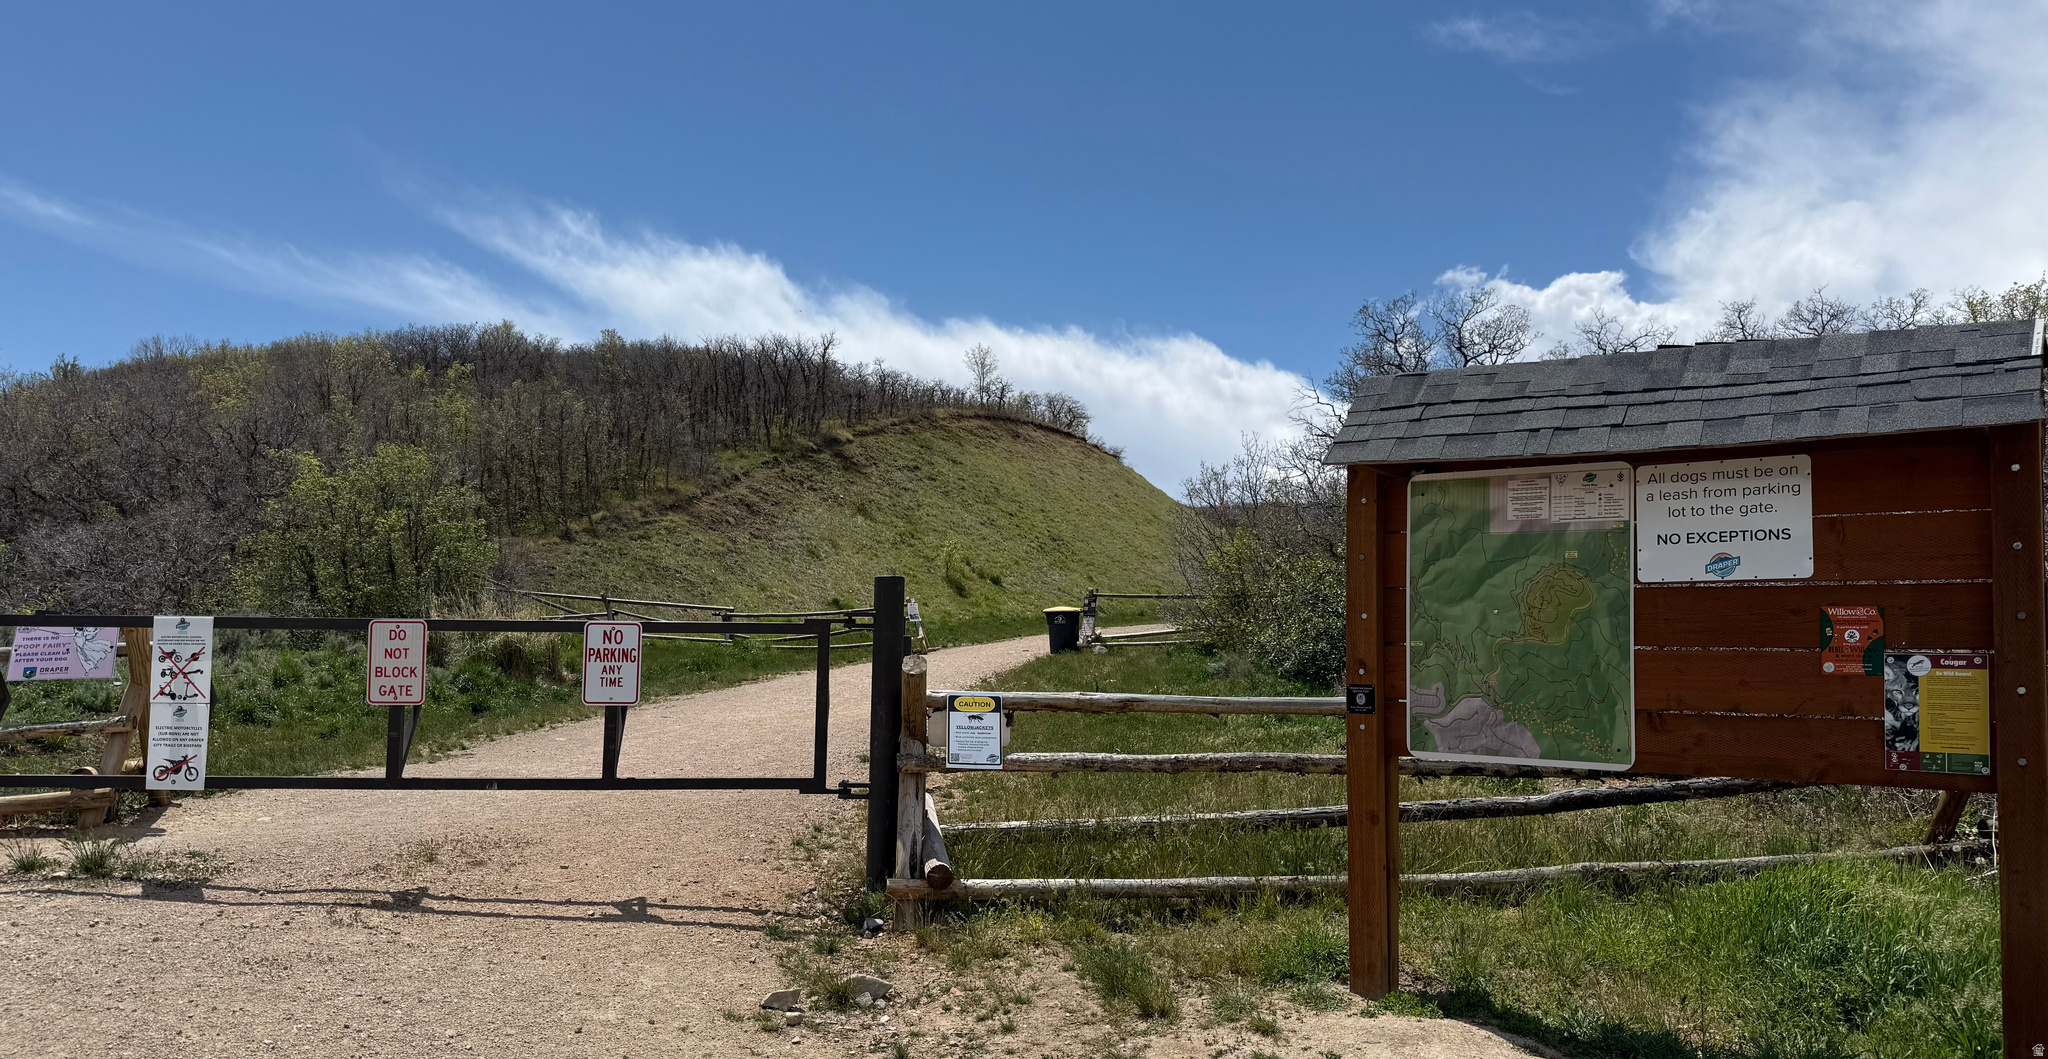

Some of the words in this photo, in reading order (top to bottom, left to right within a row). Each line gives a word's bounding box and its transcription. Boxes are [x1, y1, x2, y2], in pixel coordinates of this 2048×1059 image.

[1647, 472, 1666, 484] All
[1670, 470, 1707, 484] dogs
[1712, 467, 1749, 480] must
[1754, 465, 1774, 478] be
[1779, 465, 1799, 476] on
[1646, 492, 1654, 502] a
[1659, 488, 1698, 501] leash
[1702, 486, 1736, 498] from
[1742, 482, 1801, 499] parking
[1668, 506, 1686, 518] lot
[1691, 506, 1705, 517] to
[1710, 504, 1734, 516] the
[1739, 502, 1778, 517] gate.
[1657, 533, 1681, 545] NO
[1686, 528, 1791, 544] EXCEPTIONS
[1707, 558, 1739, 572] DRAPER
[389, 630, 407, 640] DO
[603, 630, 623, 644] NO
[384, 648, 410, 659] NOT
[588, 648, 636, 663] PARKING
[1940, 658, 1968, 667] Cougar
[375, 666, 417, 678] BLOCK
[602, 665, 622, 675] ANY
[600, 677, 623, 687] TIME
[379, 685, 412, 696] GATE
